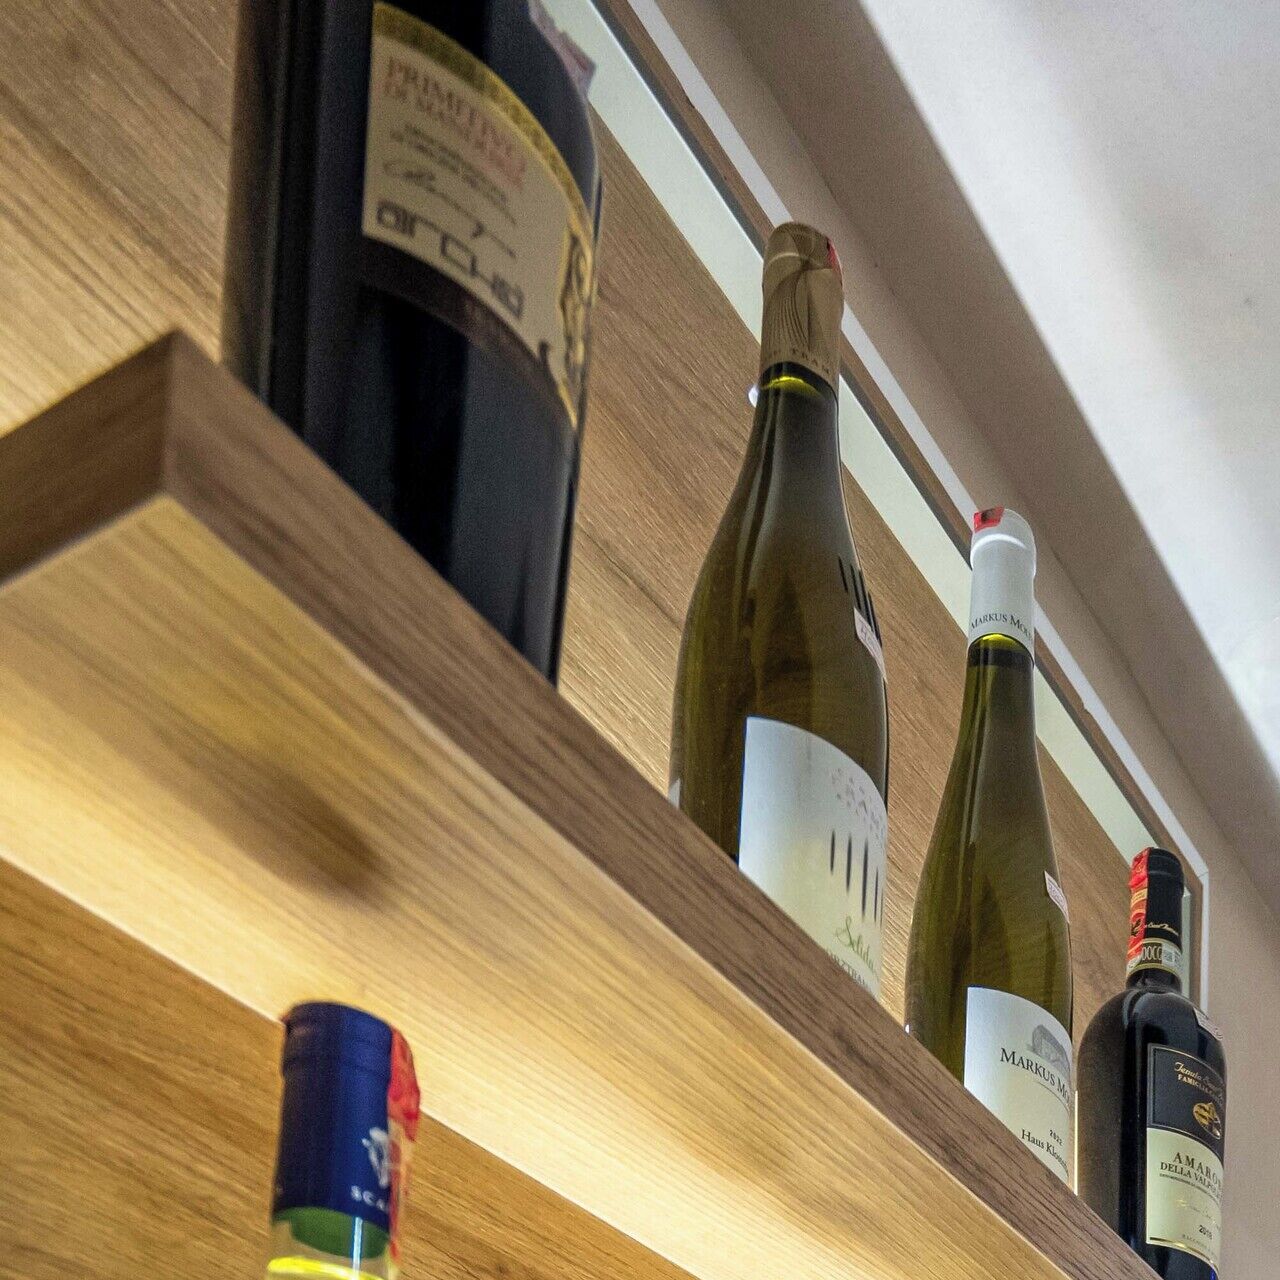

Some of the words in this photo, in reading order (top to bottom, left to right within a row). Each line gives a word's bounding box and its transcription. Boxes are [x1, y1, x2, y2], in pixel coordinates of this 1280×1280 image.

[1000, 1048, 1056, 1088] MARKUS
[1021, 1128, 1045, 1151] Haus
[1161, 1161, 1192, 1179] DELLA
